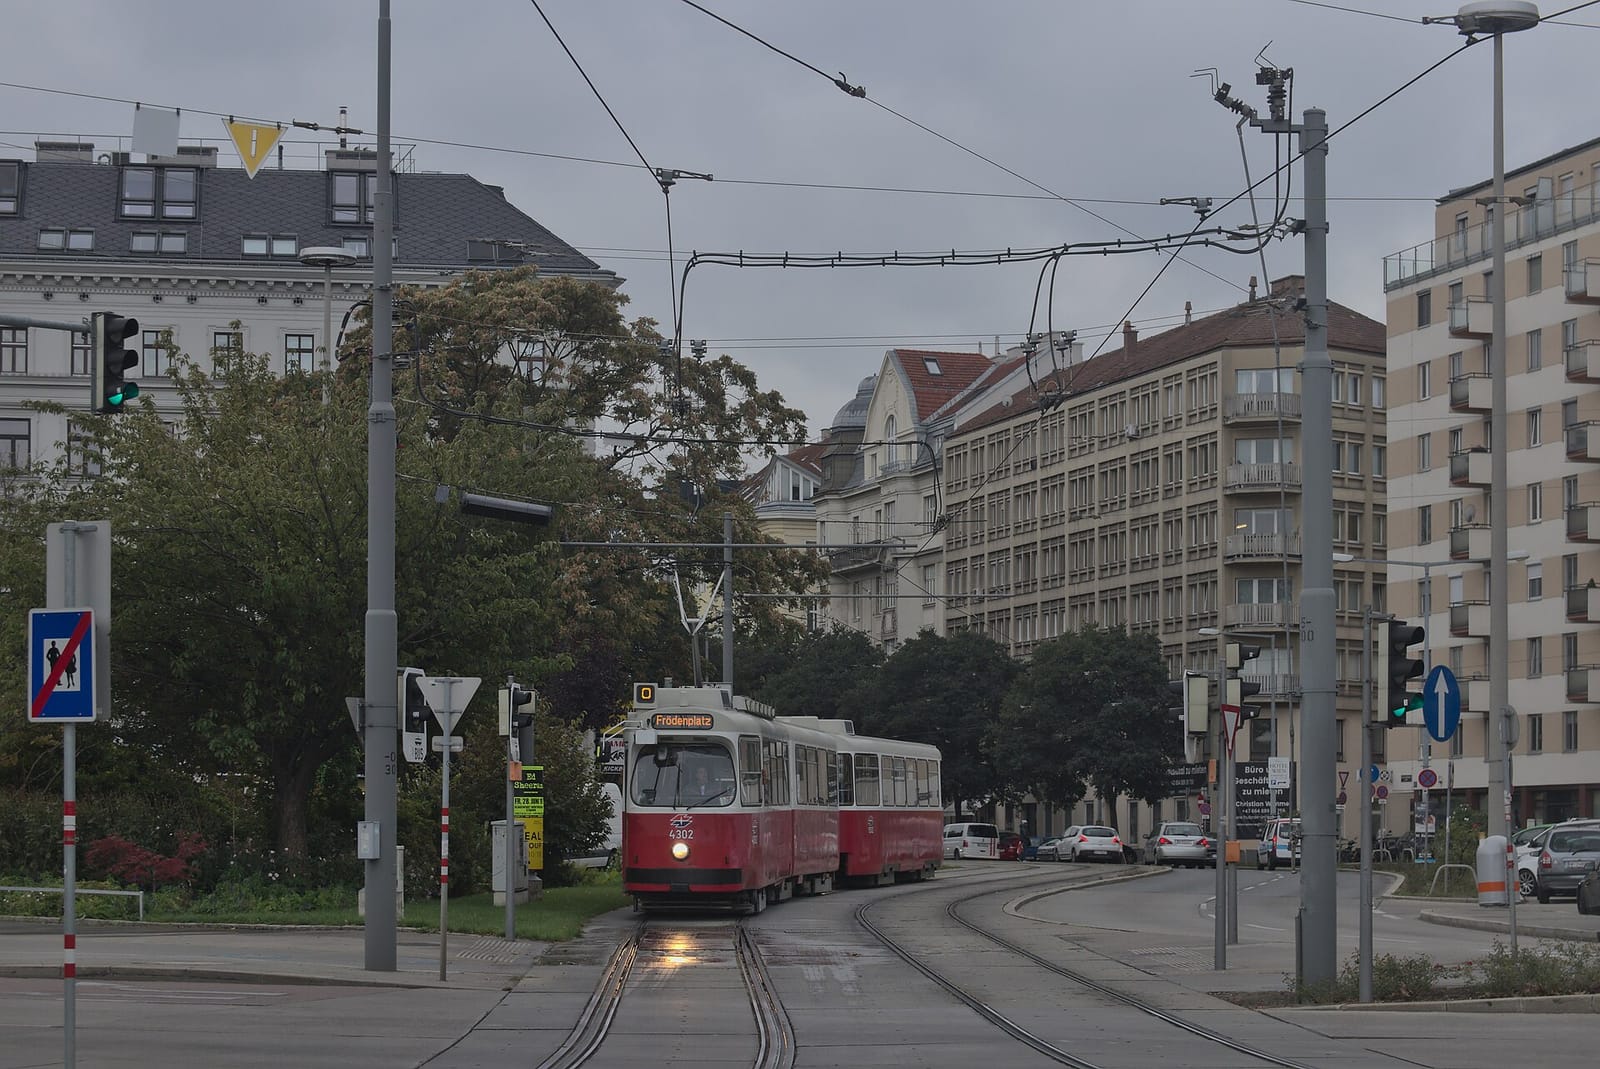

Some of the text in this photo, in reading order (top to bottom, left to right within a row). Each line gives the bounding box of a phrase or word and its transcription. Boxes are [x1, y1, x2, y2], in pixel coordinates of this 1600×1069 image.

[656, 715, 712, 727] Frödenplatz
[1244, 765, 1264, 774] Büro
[524, 832, 541, 840] EAL
[669, 829, 694, 840] 4302
